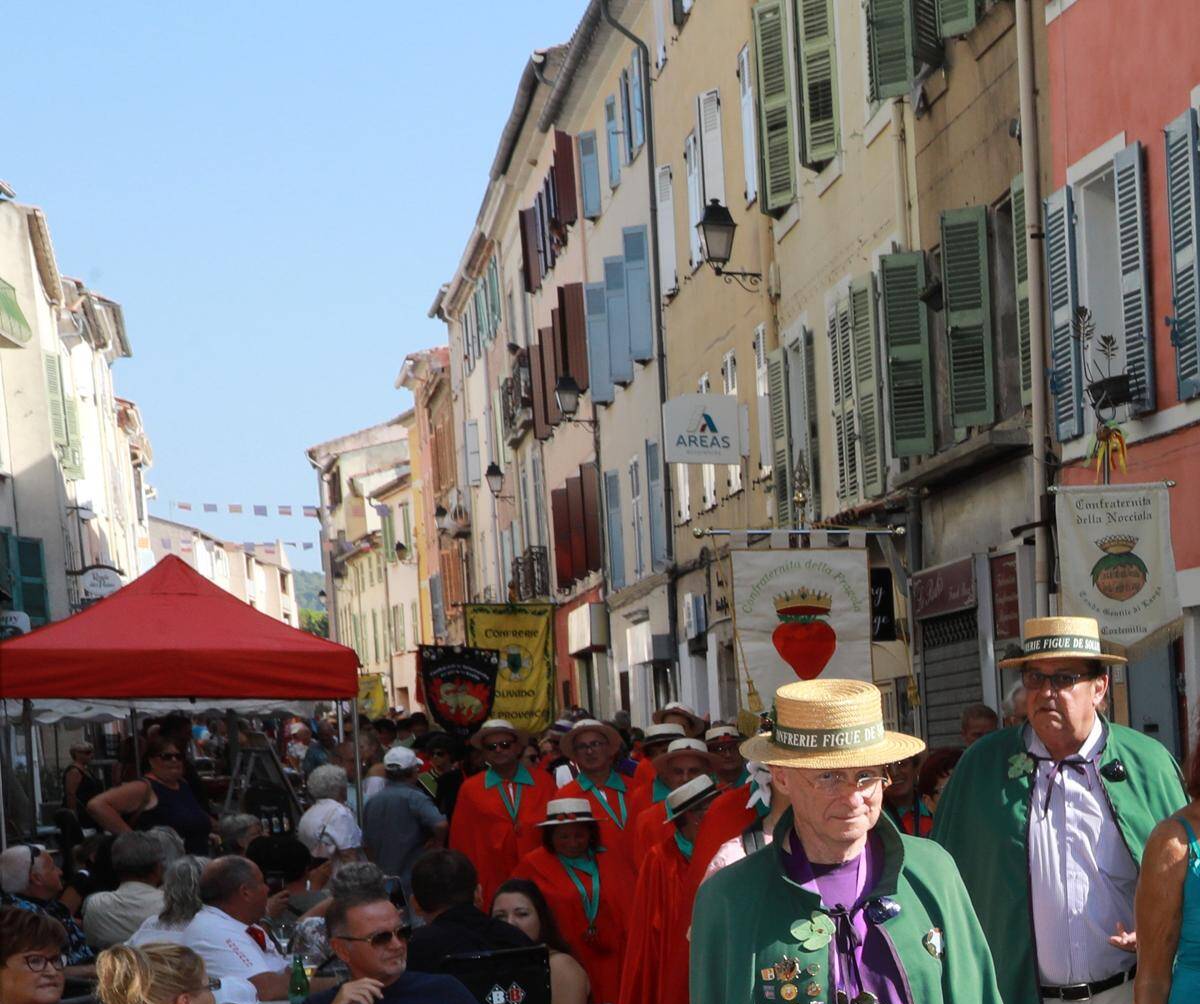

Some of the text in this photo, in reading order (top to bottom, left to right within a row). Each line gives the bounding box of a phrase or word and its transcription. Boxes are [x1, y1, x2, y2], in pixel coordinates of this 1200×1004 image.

[676, 434, 731, 449] AREAS
[1076, 510, 1152, 525] della Nocciola
[804, 559, 832, 575] della
[1043, 637, 1071, 649] FIGUE
[1073, 638, 1084, 649] DE
[823, 729, 860, 747] FIGUE
[864, 727, 876, 741] DE
